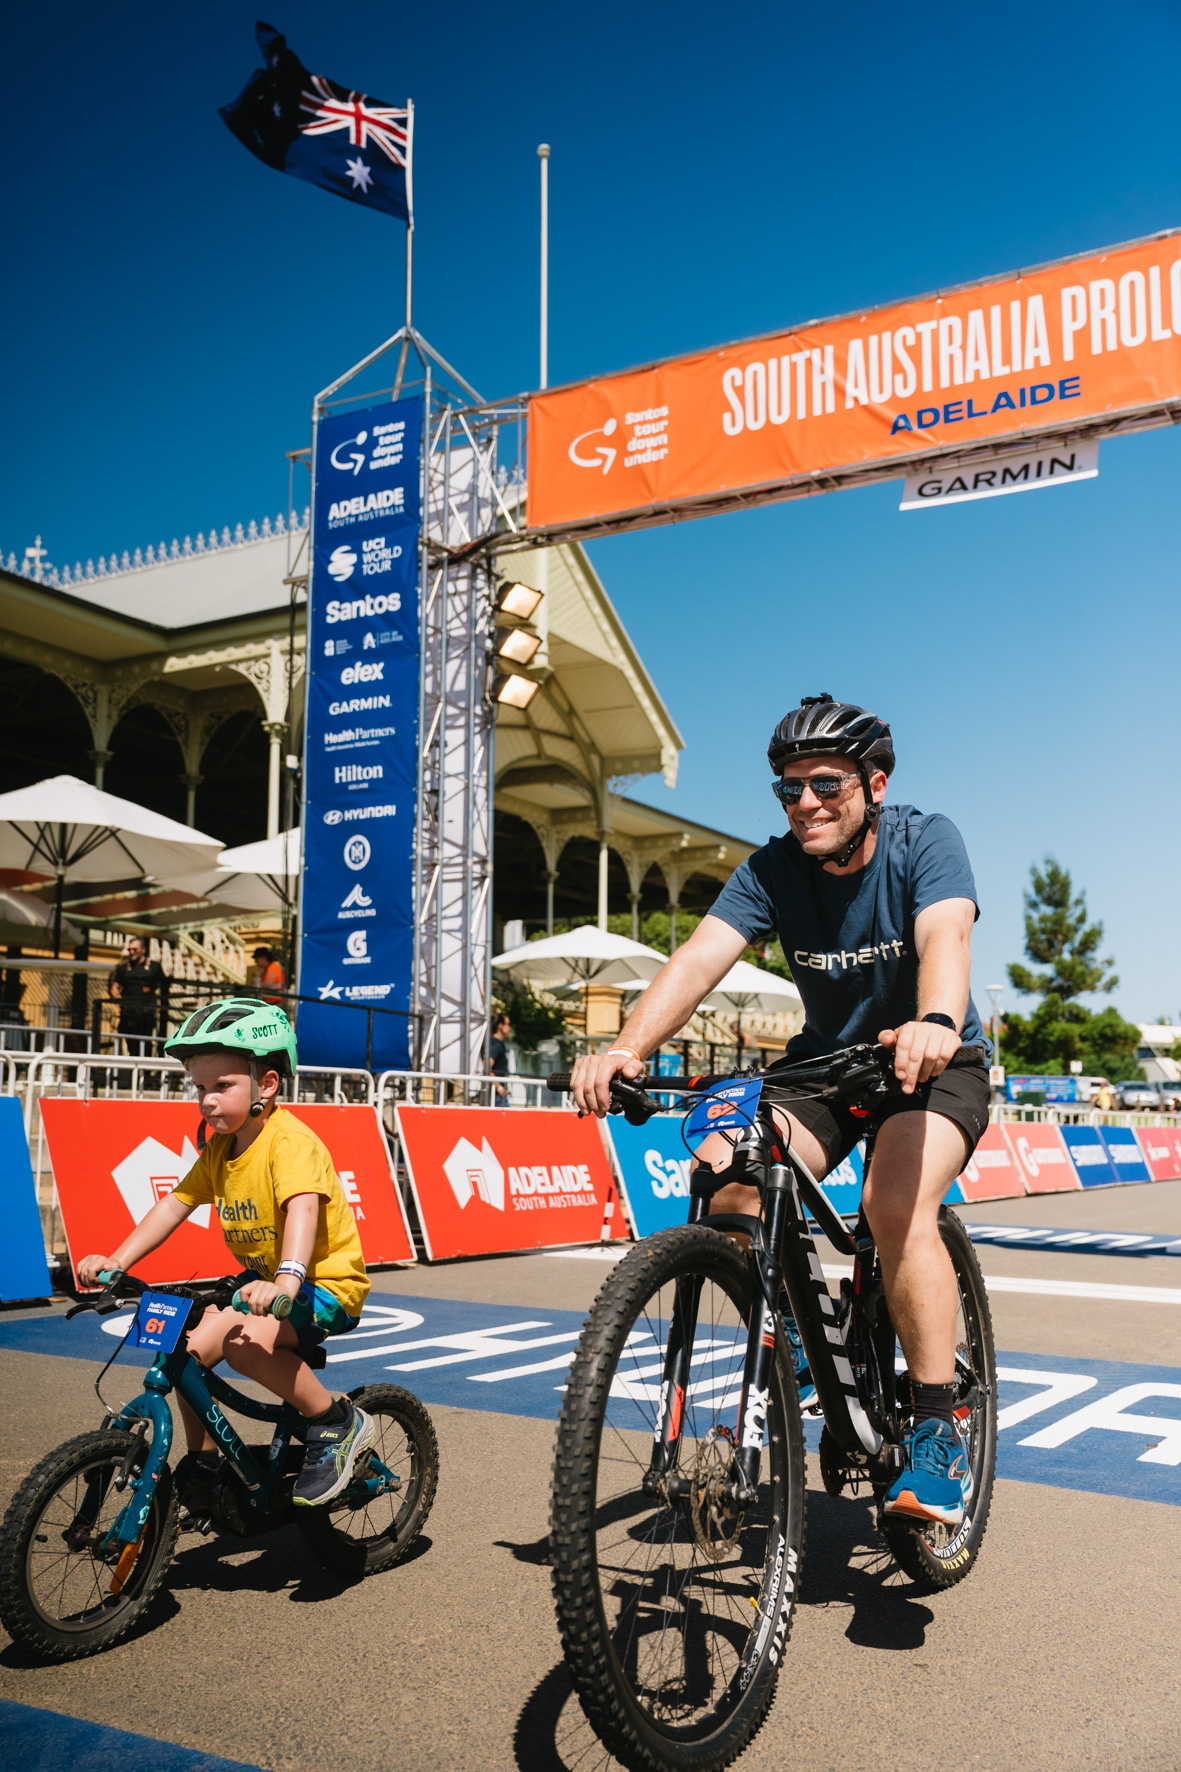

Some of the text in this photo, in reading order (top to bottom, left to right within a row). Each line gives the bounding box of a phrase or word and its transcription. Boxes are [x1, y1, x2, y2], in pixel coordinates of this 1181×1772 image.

[723, 345, 835, 436] SOUTH
[845, 294, 1051, 410] AUSTRALIA
[890, 376, 1081, 435] ADELAIDE
[625, 405, 669, 425] Santos
[372, 421, 405, 437] Santos
[633, 420, 669, 437] tour
[378, 432, 405, 446] tour
[627, 434, 668, 452] down
[372, 443, 404, 458] down
[624, 448, 669, 468] under
[369, 454, 404, 470] under
[917, 453, 1076, 498] GARMIN
[328, 486, 405, 521] ADELAIDE
[328, 505, 405, 530] SOUTH AUSTRALIA
[362, 537, 386, 552] UCI
[362, 546, 402, 564] WORLD
[362, 560, 392, 576] TOUR
[326, 592, 401, 624] Santos
[340, 661, 385, 685] efex
[328, 694, 392, 716] GARMIN
[334, 764, 383, 784] Hilton
[344, 804, 397, 822] HYUNDAI
[337, 908, 377, 919] AUSCYCLING
[345, 984, 391, 997] LEGEND
[251, 1024, 278, 1039] SCOTT
[707, 1101, 738, 1119] 62
[508, 1164, 595, 1195] ADELAIDE
[512, 1193, 598, 1211] SOUTH AUSTRALIA
[223, 1226, 279, 1243] artners
[145, 1318, 166, 1334] 61
[742, 1384, 770, 1452] FOX
[941, 1547, 970, 1570] MAXXIS
[766, 1533, 785, 1619] ALEXRIMS
[769, 1547, 798, 1667] MAXXIS
